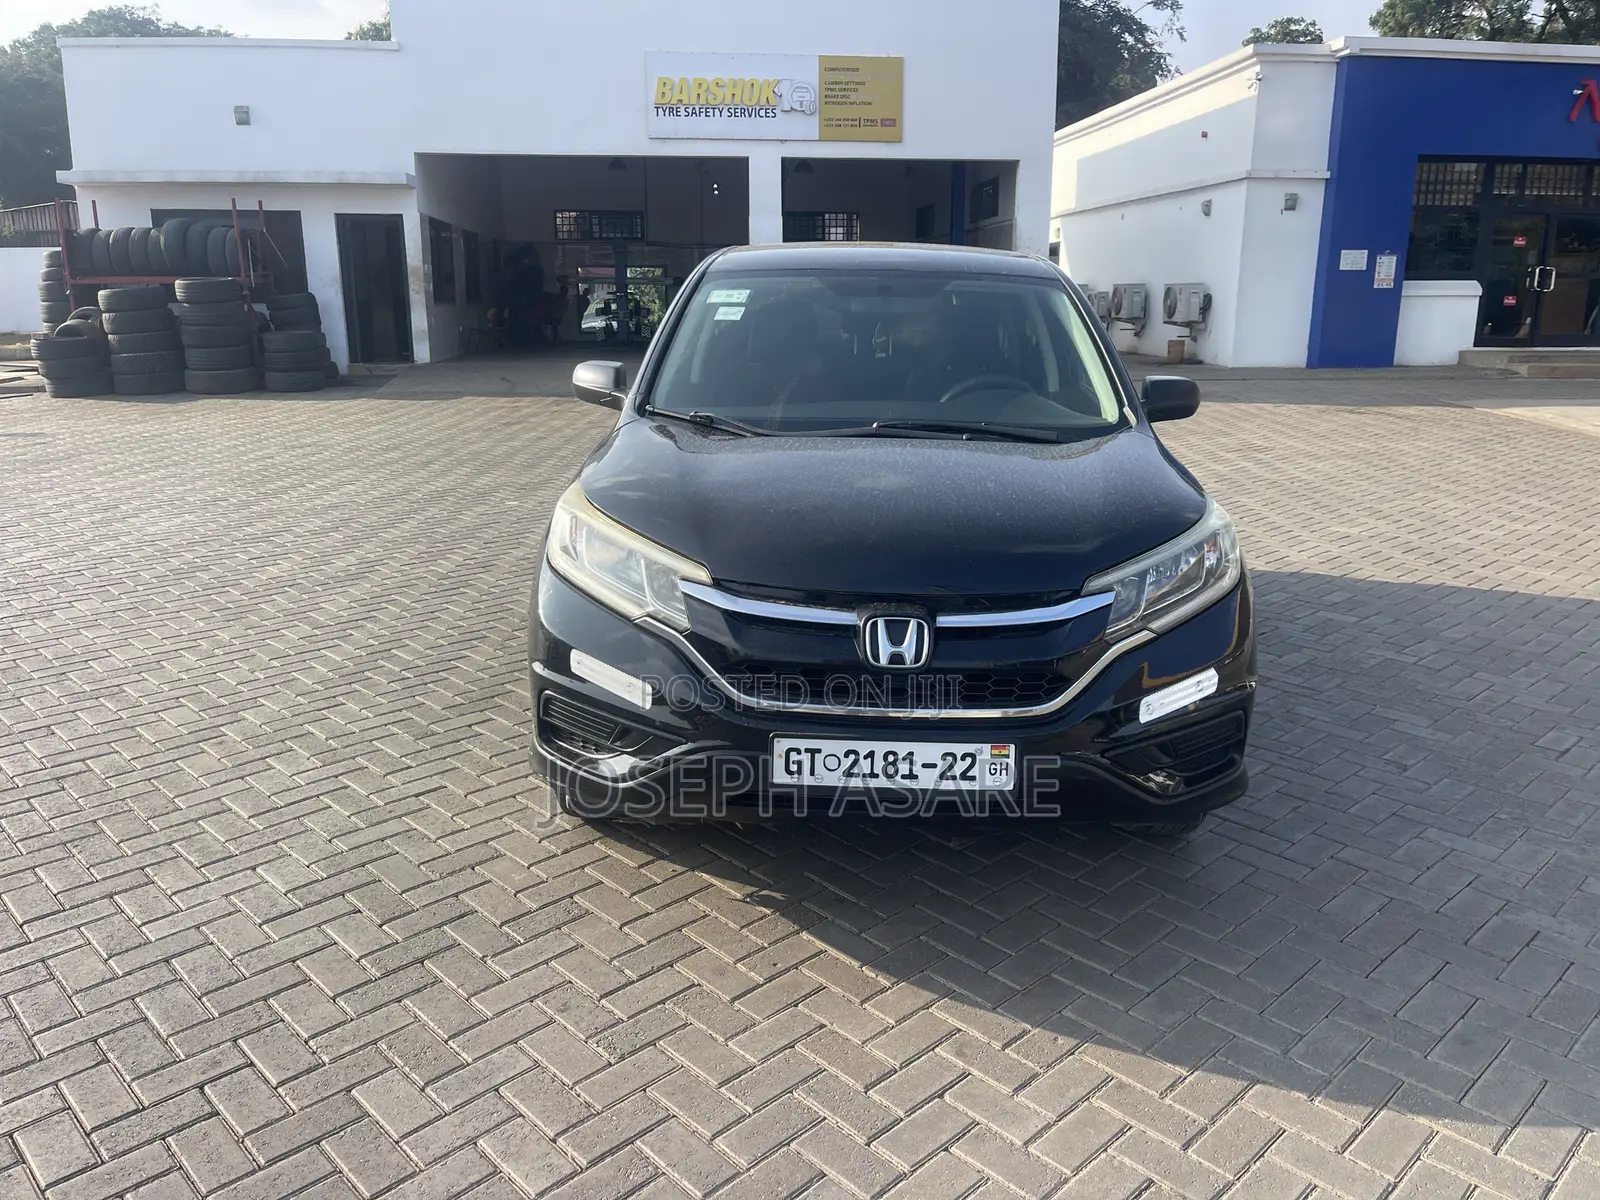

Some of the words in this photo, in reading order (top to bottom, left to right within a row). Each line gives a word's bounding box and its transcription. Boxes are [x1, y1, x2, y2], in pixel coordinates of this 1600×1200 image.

[654, 77, 780, 106] BARSHOK
[654, 106, 682, 117] TYRE
[684, 106, 725, 118] SAFETY
[727, 107, 777, 118] SERVICES
[784, 747, 823, 776] GT
[842, 749, 978, 781] 2181-22
[988, 762, 1009, 776] GH
